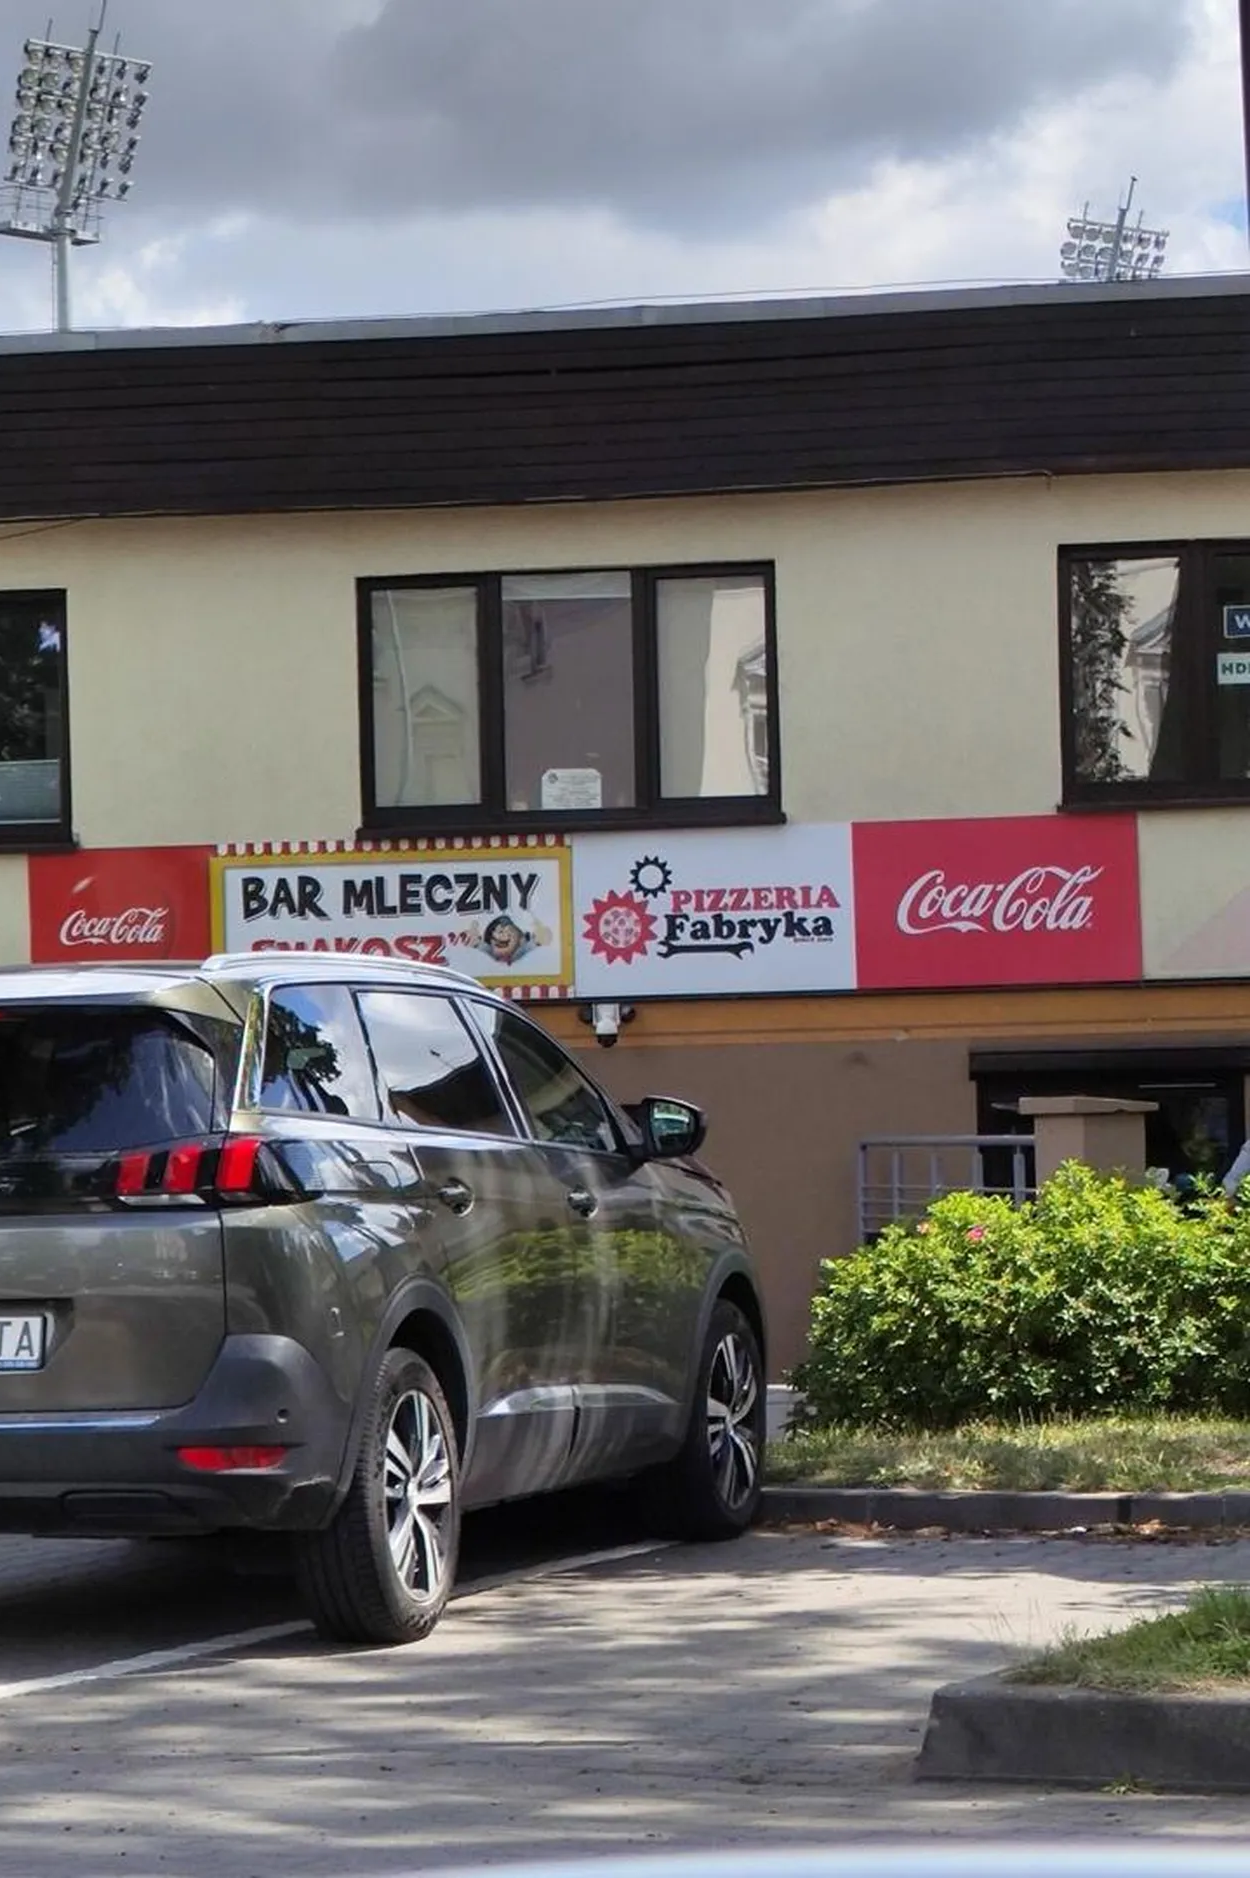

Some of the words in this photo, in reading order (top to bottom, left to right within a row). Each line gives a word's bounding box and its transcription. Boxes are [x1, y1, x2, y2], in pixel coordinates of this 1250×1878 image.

[241, 875, 331, 922] BAR
[342, 872, 540, 919] MLECZNY
[670, 885, 841, 913] PIZZERIA
[897, 865, 1104, 934] Coca-Cola
[59, 907, 169, 946] Coca-Cola
[664, 911, 834, 944] Fabryka
